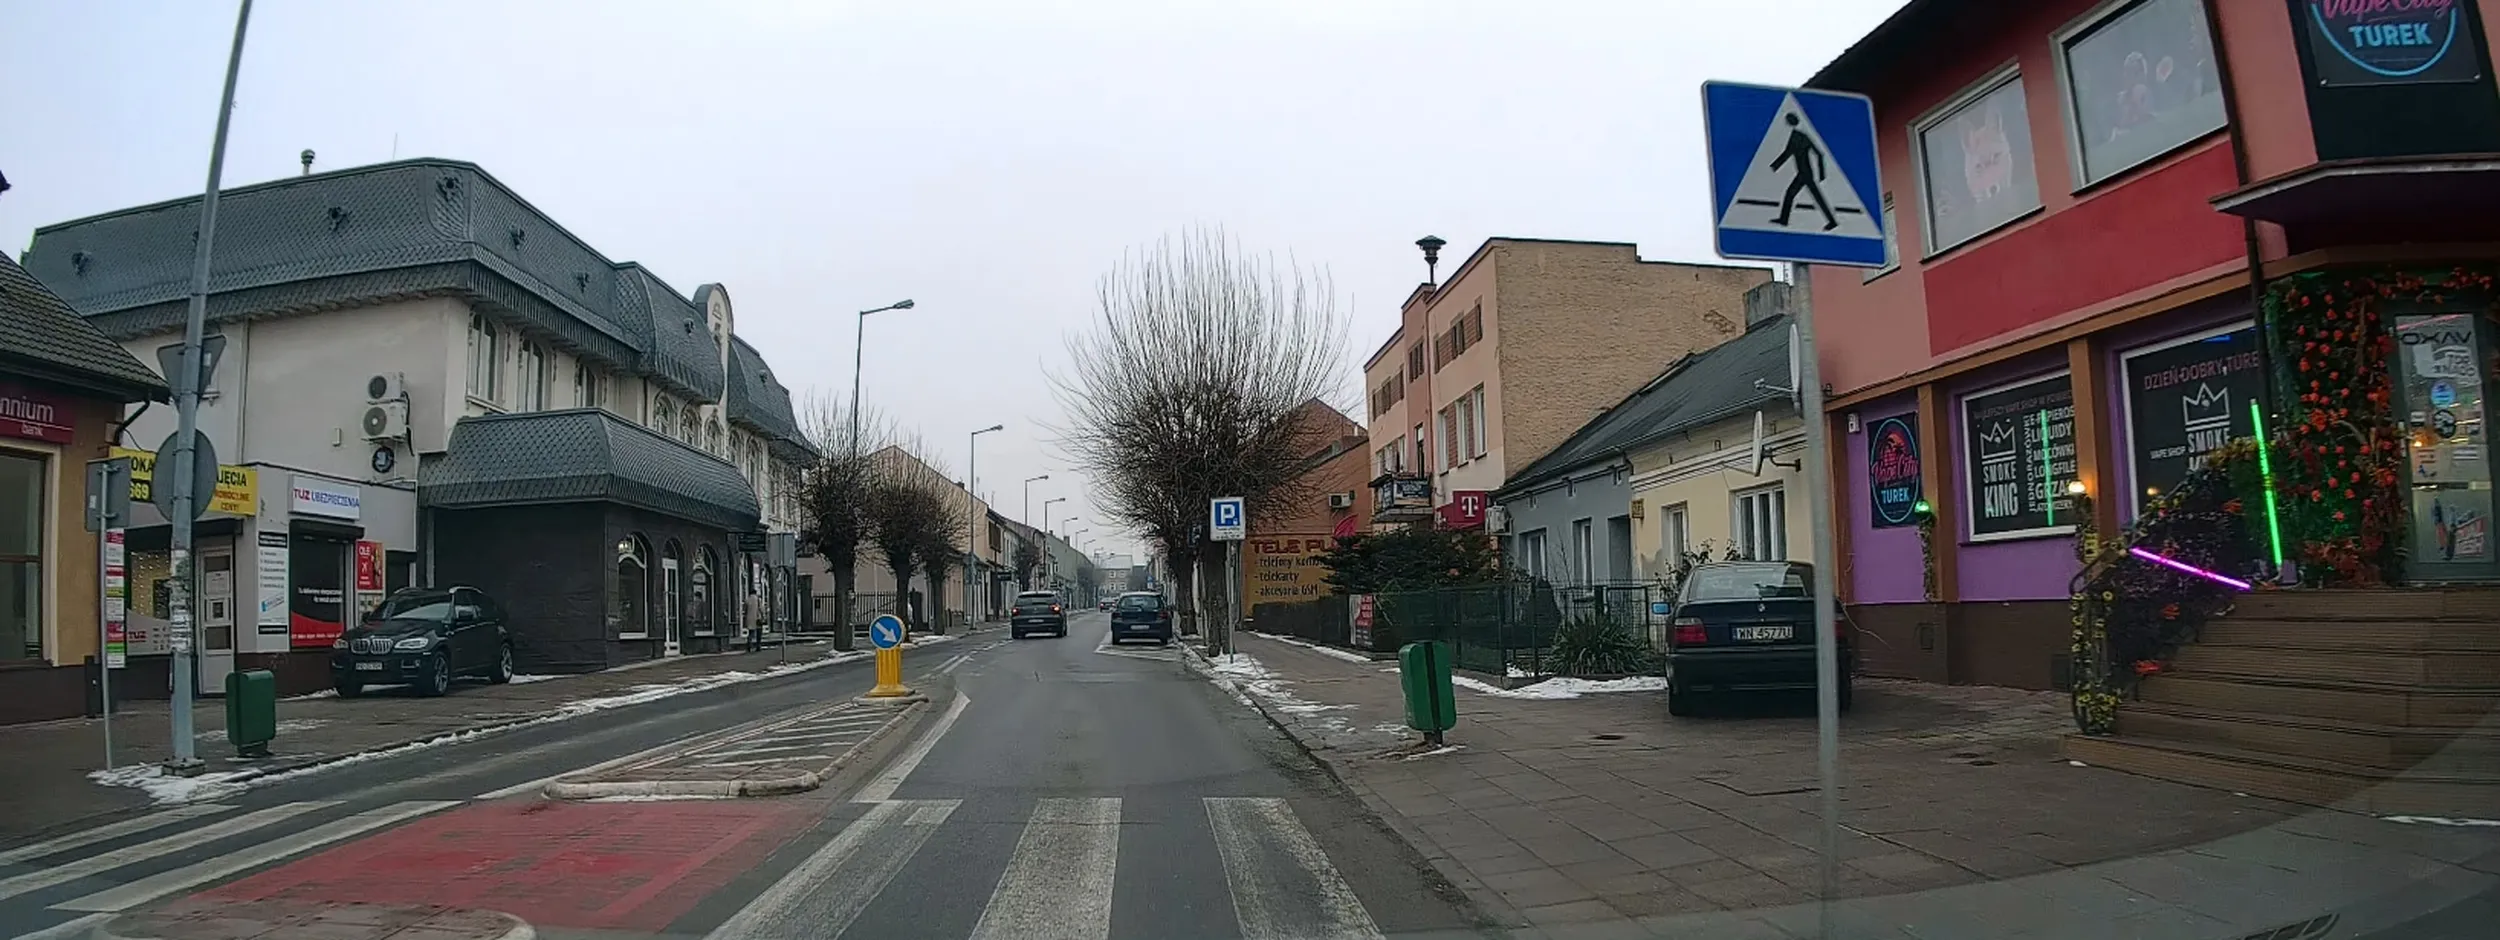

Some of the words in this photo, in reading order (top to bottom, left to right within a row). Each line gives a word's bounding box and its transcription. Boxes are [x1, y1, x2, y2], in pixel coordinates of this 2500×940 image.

[2348, 23, 2433, 48] TUREK
[21, 422, 44, 436] bank
[2032, 421, 2073, 442] LIUIDY
[1983, 461, 2016, 483] SMOKE
[2034, 460, 2077, 479] LOGFILE
[293, 488, 310, 501] TUZ
[1881, 488, 1909, 504] TUREK
[1984, 482, 2018, 518] KING
[1221, 504, 1235, 524] P
[1250, 539, 1300, 554] TELE
